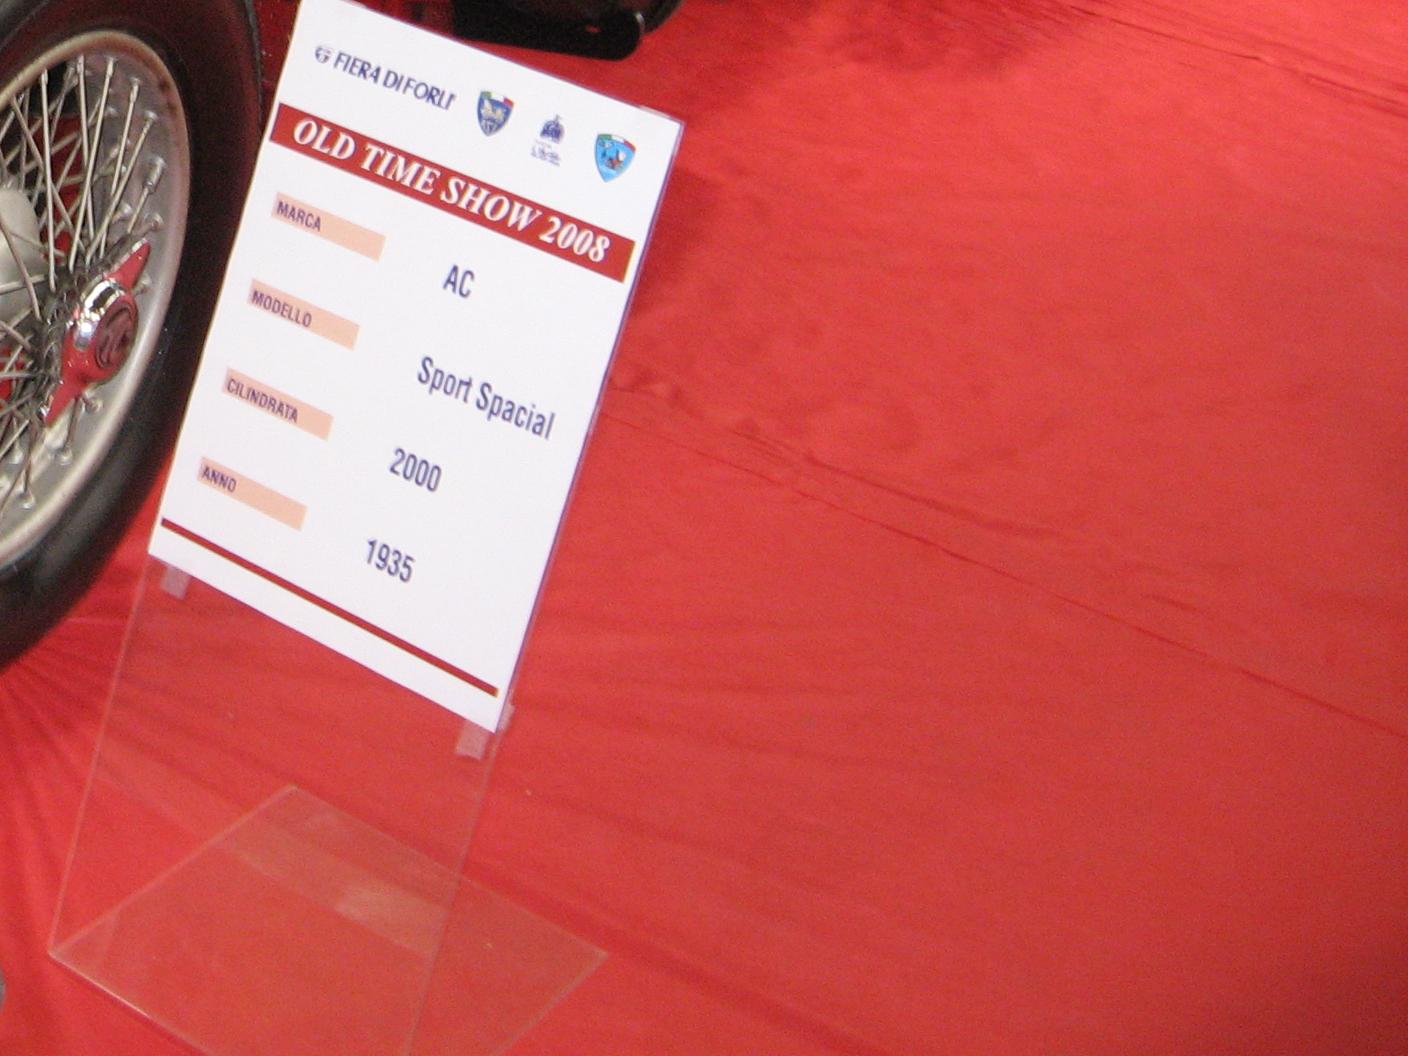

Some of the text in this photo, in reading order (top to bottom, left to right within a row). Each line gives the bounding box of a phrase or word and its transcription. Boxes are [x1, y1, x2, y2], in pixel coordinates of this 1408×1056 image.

[333, 50, 381, 83] FIERA
[382, 70, 404, 91] DI
[293, 119, 611, 263] OLD TIME SHOW 2008
[276, 201, 322, 232] MARCA
[443, 265, 476, 298] AC
[251, 290, 313, 328] MODELLO
[226, 378, 299, 424] CILINDRATA
[417, 356, 556, 440] Sport Spacial
[201, 465, 238, 493] ANNO
[390, 448, 442, 492] 2000
[365, 538, 416, 584] 1935
